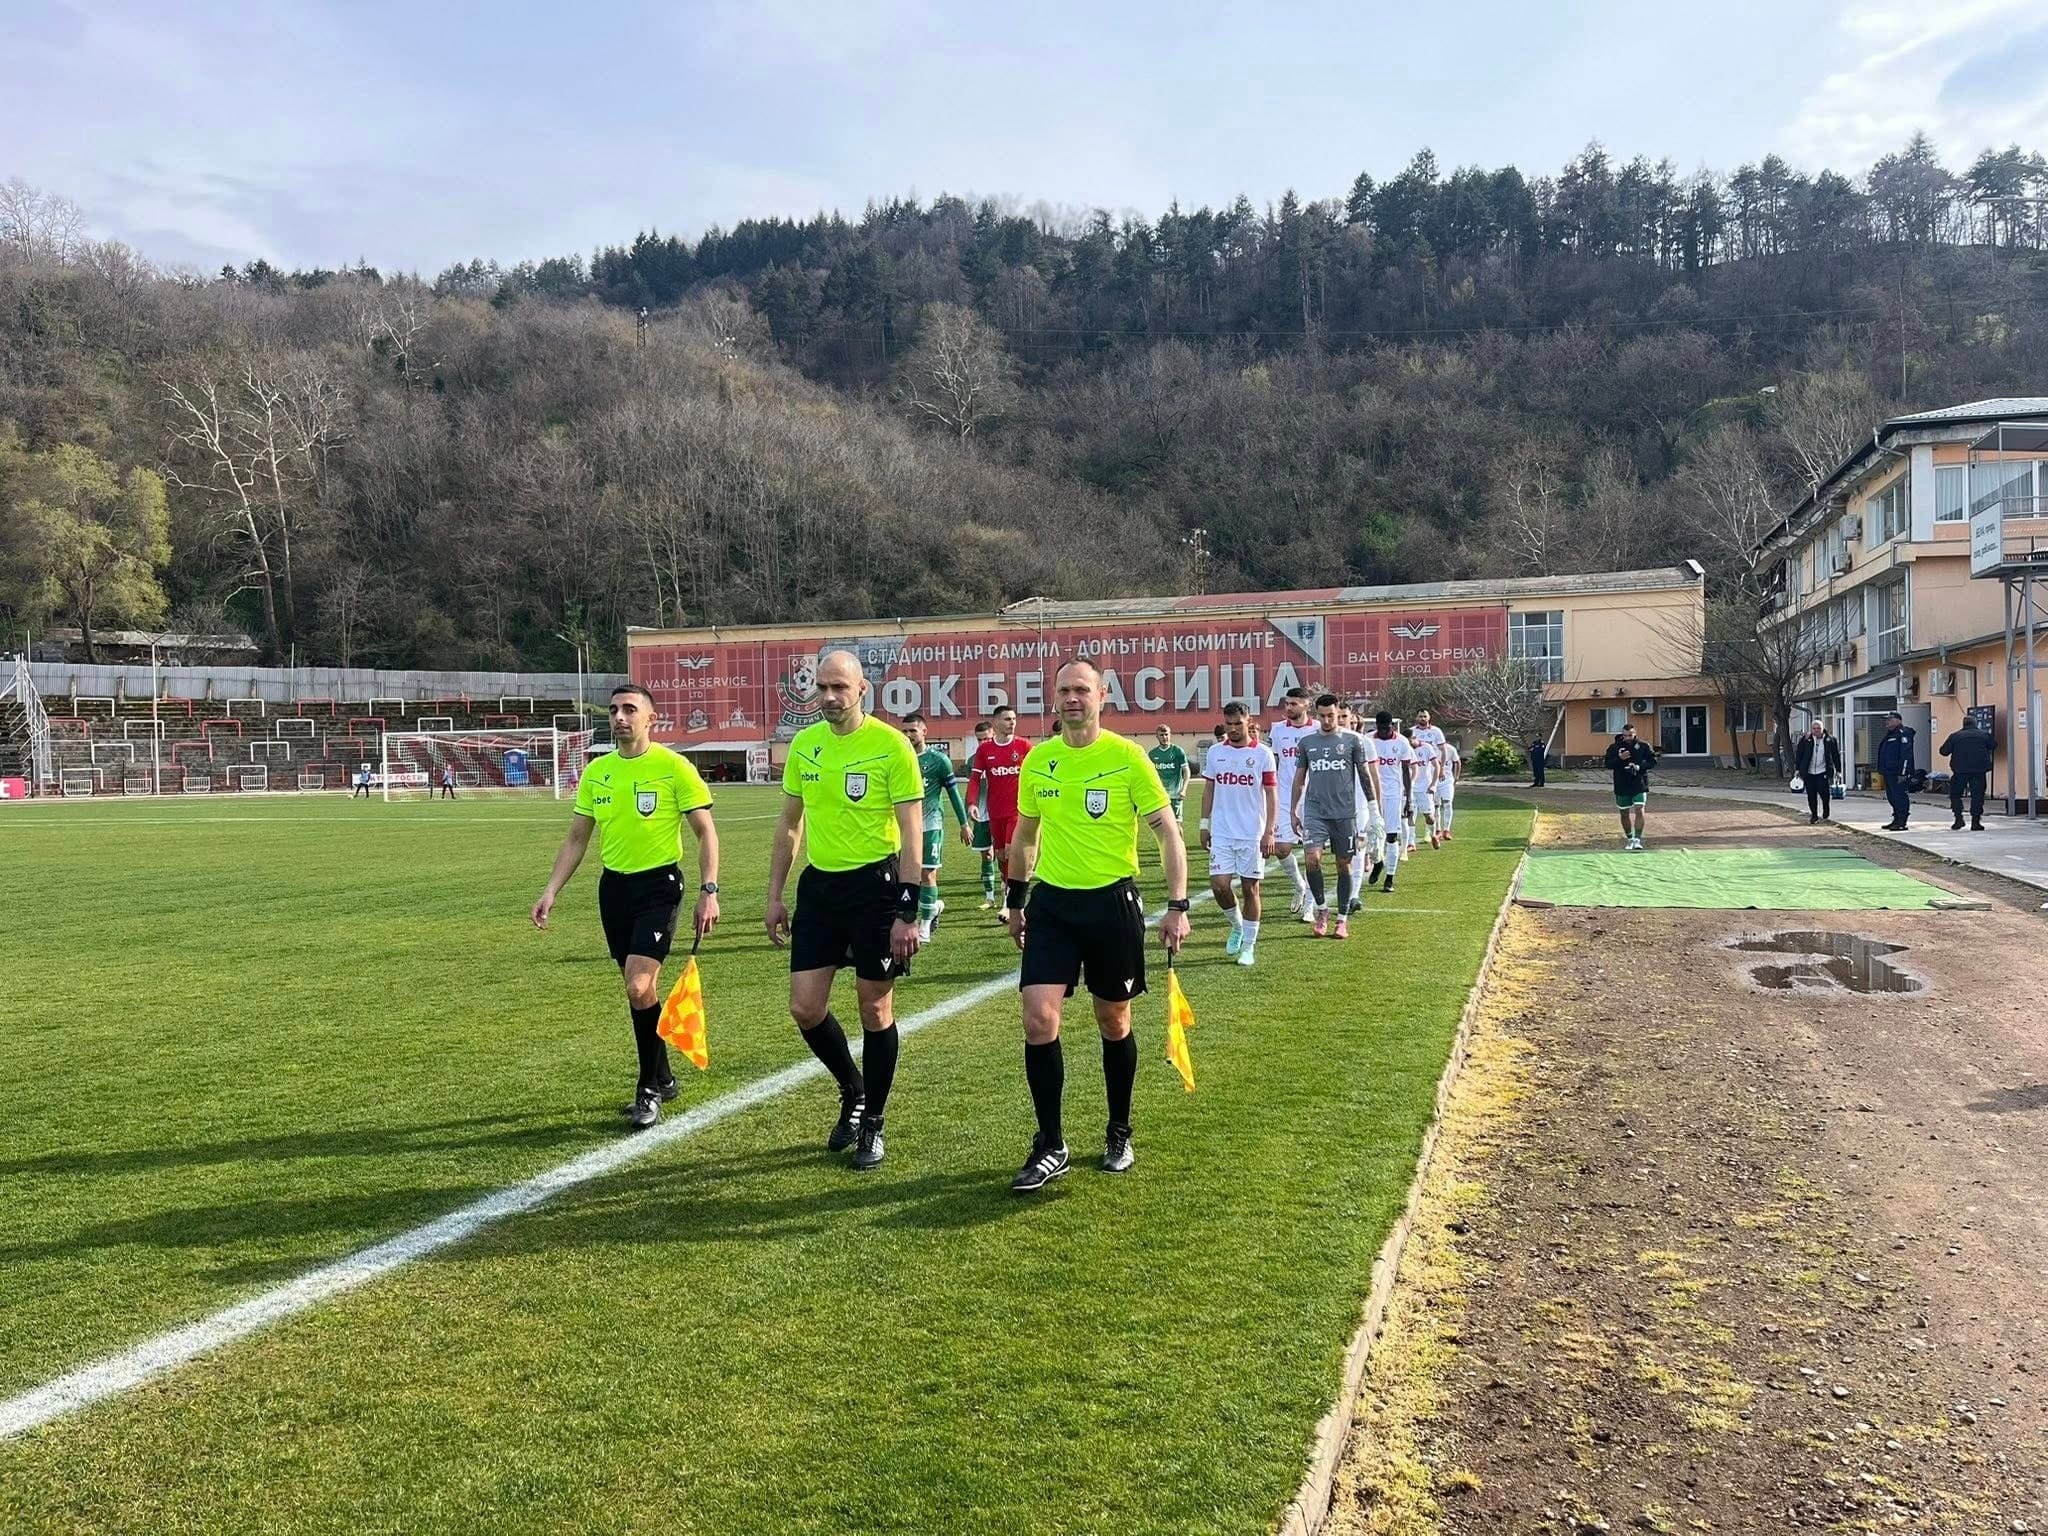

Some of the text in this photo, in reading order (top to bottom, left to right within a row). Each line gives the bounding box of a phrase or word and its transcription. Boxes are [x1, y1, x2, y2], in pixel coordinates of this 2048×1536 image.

[867, 645, 945, 666] СТАДИОН
[949, 644, 983, 662] ЦАР
[987, 640, 1060, 659] САМУИЛ
[1077, 636, 1138, 657] ДОМЪТ
[1144, 636, 1169, 653] НА
[1173, 631, 1275, 652] КОМИТИТЕ
[1348, 647, 1485, 663] ВАН КАР СЪРВИЗ
[1400, 664, 1431, 674] ЕООД
[645, 676, 748, 689] VAN CAR SERVICE
[978, 661, 1303, 716] БЕАСИЦА
[688, 690, 703, 699] LTD
[990, 766, 1020, 776] efbet
[1309, 757, 1347, 771] efbet
[1215, 772, 1254, 786] efbet
